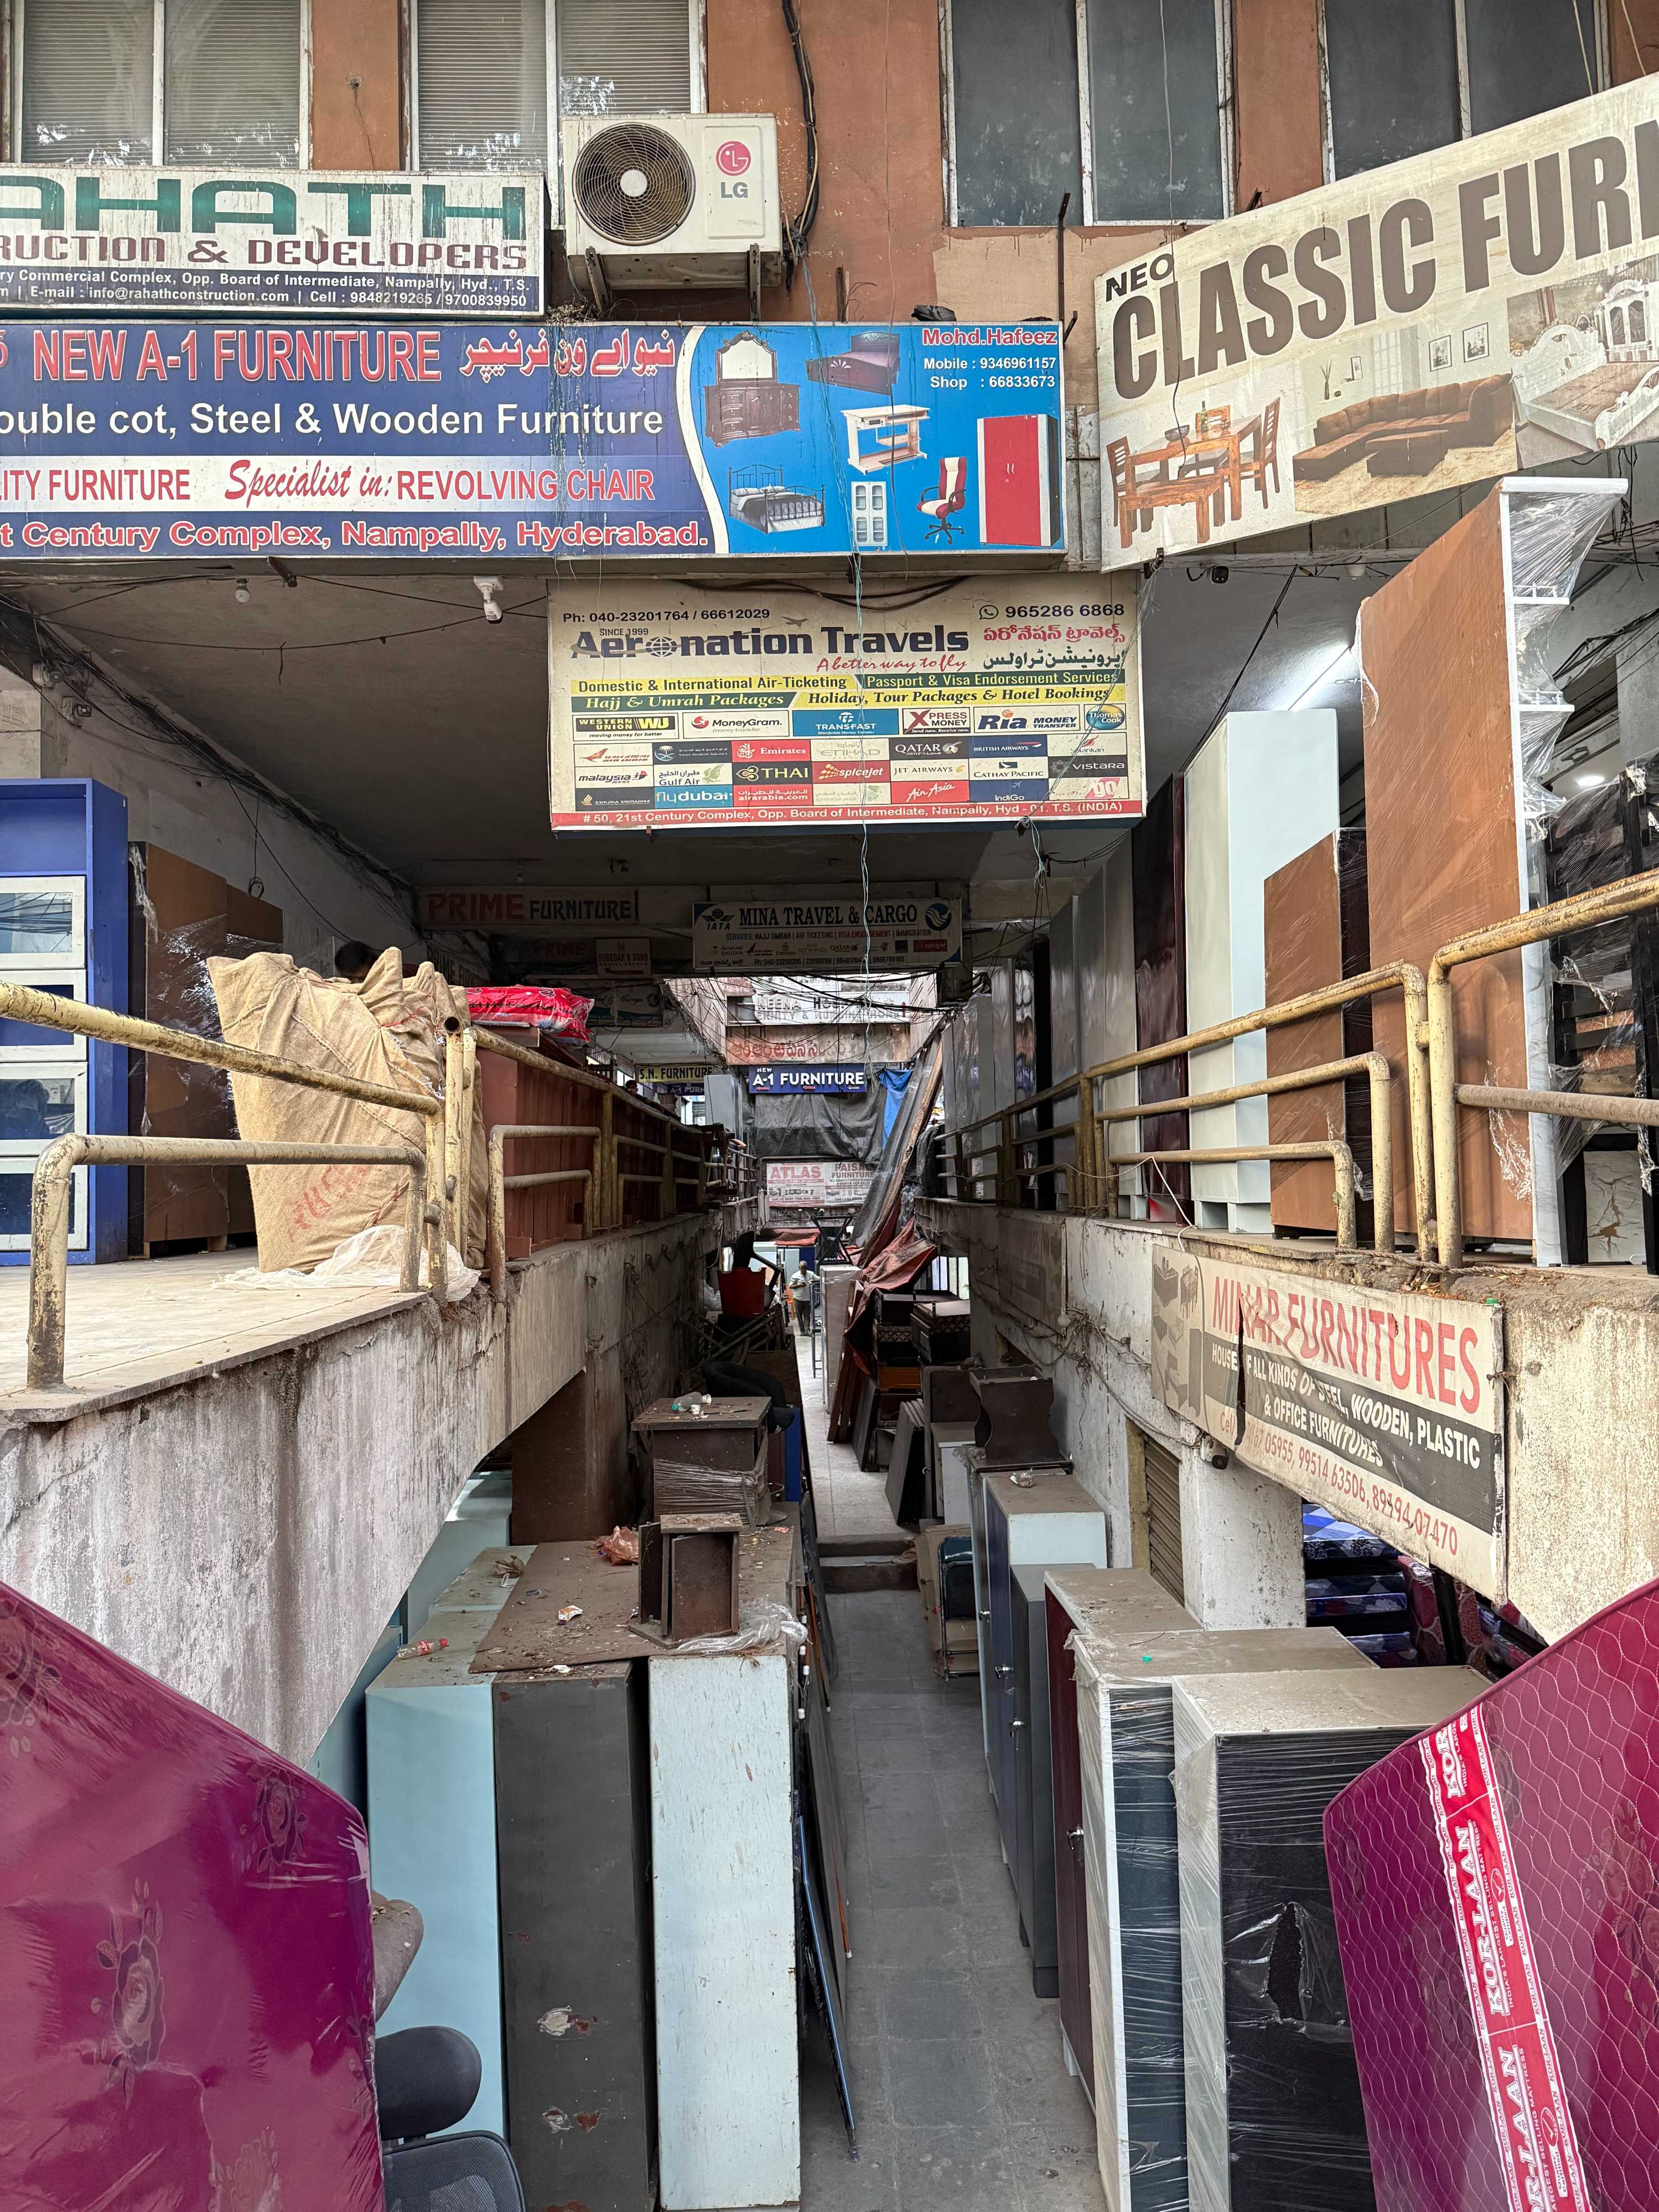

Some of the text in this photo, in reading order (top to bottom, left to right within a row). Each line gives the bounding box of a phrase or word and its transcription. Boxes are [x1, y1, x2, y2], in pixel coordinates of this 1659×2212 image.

[720, 182, 748, 199] LG
[188, 240, 229, 263] &
[248, 240, 526, 270] DEVELOPERS
[19, 270, 530, 294] Commercial Complex, Opp. Board of Intermediate, Nampally, Hyd., T.S.
[1106, 253, 1174, 302] NEO
[32, 286, 527, 307] E-mail info@rahathconstruction.com Cell 9848219265 9700839950
[1113, 198, 1436, 399] CLASSIC
[922, 327, 1057, 346] Mohd.Hafeez
[33, 330, 441, 382] NEW A-1 FURNITURE
[924, 357, 1056, 370] Mobile 9346961157
[930, 376, 1055, 391] Shop 66833673
[110, 404, 177, 439] cot,
[190, 403, 281, 434] Steel
[295, 403, 322, 434] &
[333, 403, 482, 434] Wooden
[498, 403, 662, 434] Furniture
[49, 469, 190, 500] FURNITURE
[225, 459, 655, 508] Specialist in: REVOLVING CHAIR
[22, 521, 708, 552] Century Complex, Nampally, Hyderabad.
[563, 609, 770, 622] Ph: 040-23201764 66612029
[1005, 604, 1125, 618] 965286 6868
[820, 625, 969, 653] Travels
[579, 676, 847, 692] Domestic & International Air-Ticketing
[867, 671, 1117, 689] Passport & Visa Endorsement Services
[585, 694, 784, 711] Hajj & Umrah Packages
[808, 687, 1110, 706] Holiday, Tour Packages & Hotel Bookings
[638, 717, 669, 730] WU
[978, 709, 1028, 729] Ria
[894, 744, 941, 754] QATAR
[578, 775, 631, 783] malaysia
[760, 767, 808, 778] THAI
[656, 791, 729, 803] flydubai
[594, 814, 613, 823] 50,
[615, 813, 642, 822] 21st
[645, 812, 694, 822] Century
[697, 810, 754, 821] Complex,
[758, 809, 786, 820] Opp.
[790, 809, 827, 818] Board
[831, 808, 843, 817] of
[847, 807, 928, 817] Intermediate,
[932, 805, 992, 816] Nampally,
[996, 805, 1019, 815] Hyd
[1077, 802, 1123, 813] (INDIA)
[428, 893, 631, 922] PRIME FURNITURE
[739, 905, 917, 926] MINA TRAVEL & CARGO
[640, 1068, 657, 1079] S.N.
[753, 1072, 864, 1086] A-1 FURNITURE
[770, 1166, 822, 1179] ATLAS
[1212, 1276, 1480, 1414] MINAR FURNITURES
[1212, 1343, 1238, 1372] HOUSE
[1253, 1356, 1267, 1382] ALL
[1268, 1361, 1298, 1391] KINDS
[1299, 1372, 1315, 1396] OF
[1351, 1393, 1413, 1447] WOODEN,
[1417, 1420, 1481, 1470] PLASTIC
[1263, 1393, 1383, 1467] & OFFICE FURNITURES
[1299, 1448, 1329, 1482] 99514
[1331, 1462, 1370, 1510] 63506,
[1413, 1508, 1458, 1556] 07470
[1483, 1876, 1495, 1917] SELLING
[1455, 1825, 1505, 2016] KOR-LAAN
[1491, 1920, 1506, 1967] LARGEST
[1503, 1971, 1514, 2008] INDIA'S
